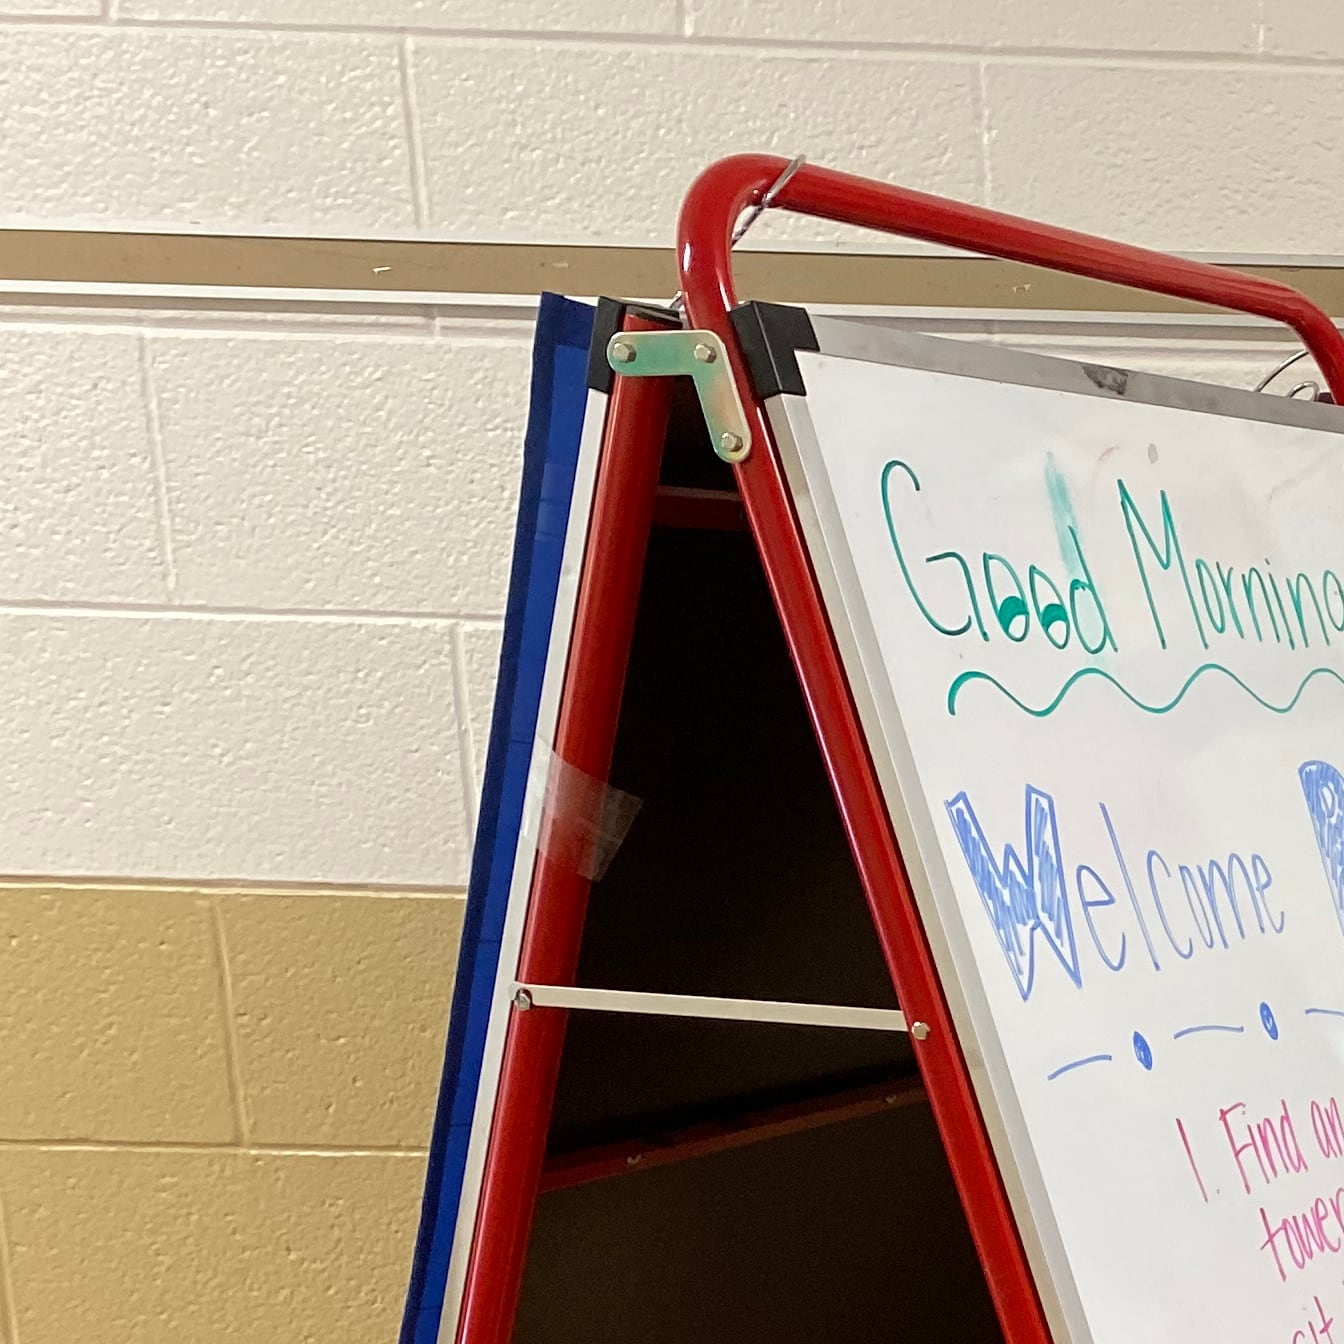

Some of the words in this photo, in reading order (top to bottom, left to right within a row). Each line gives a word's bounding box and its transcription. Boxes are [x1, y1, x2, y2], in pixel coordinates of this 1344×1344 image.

[881, 460, 1119, 655] Good
[944, 783, 1285, 1002] Welcome
[1219, 1099, 1309, 1196] Find
